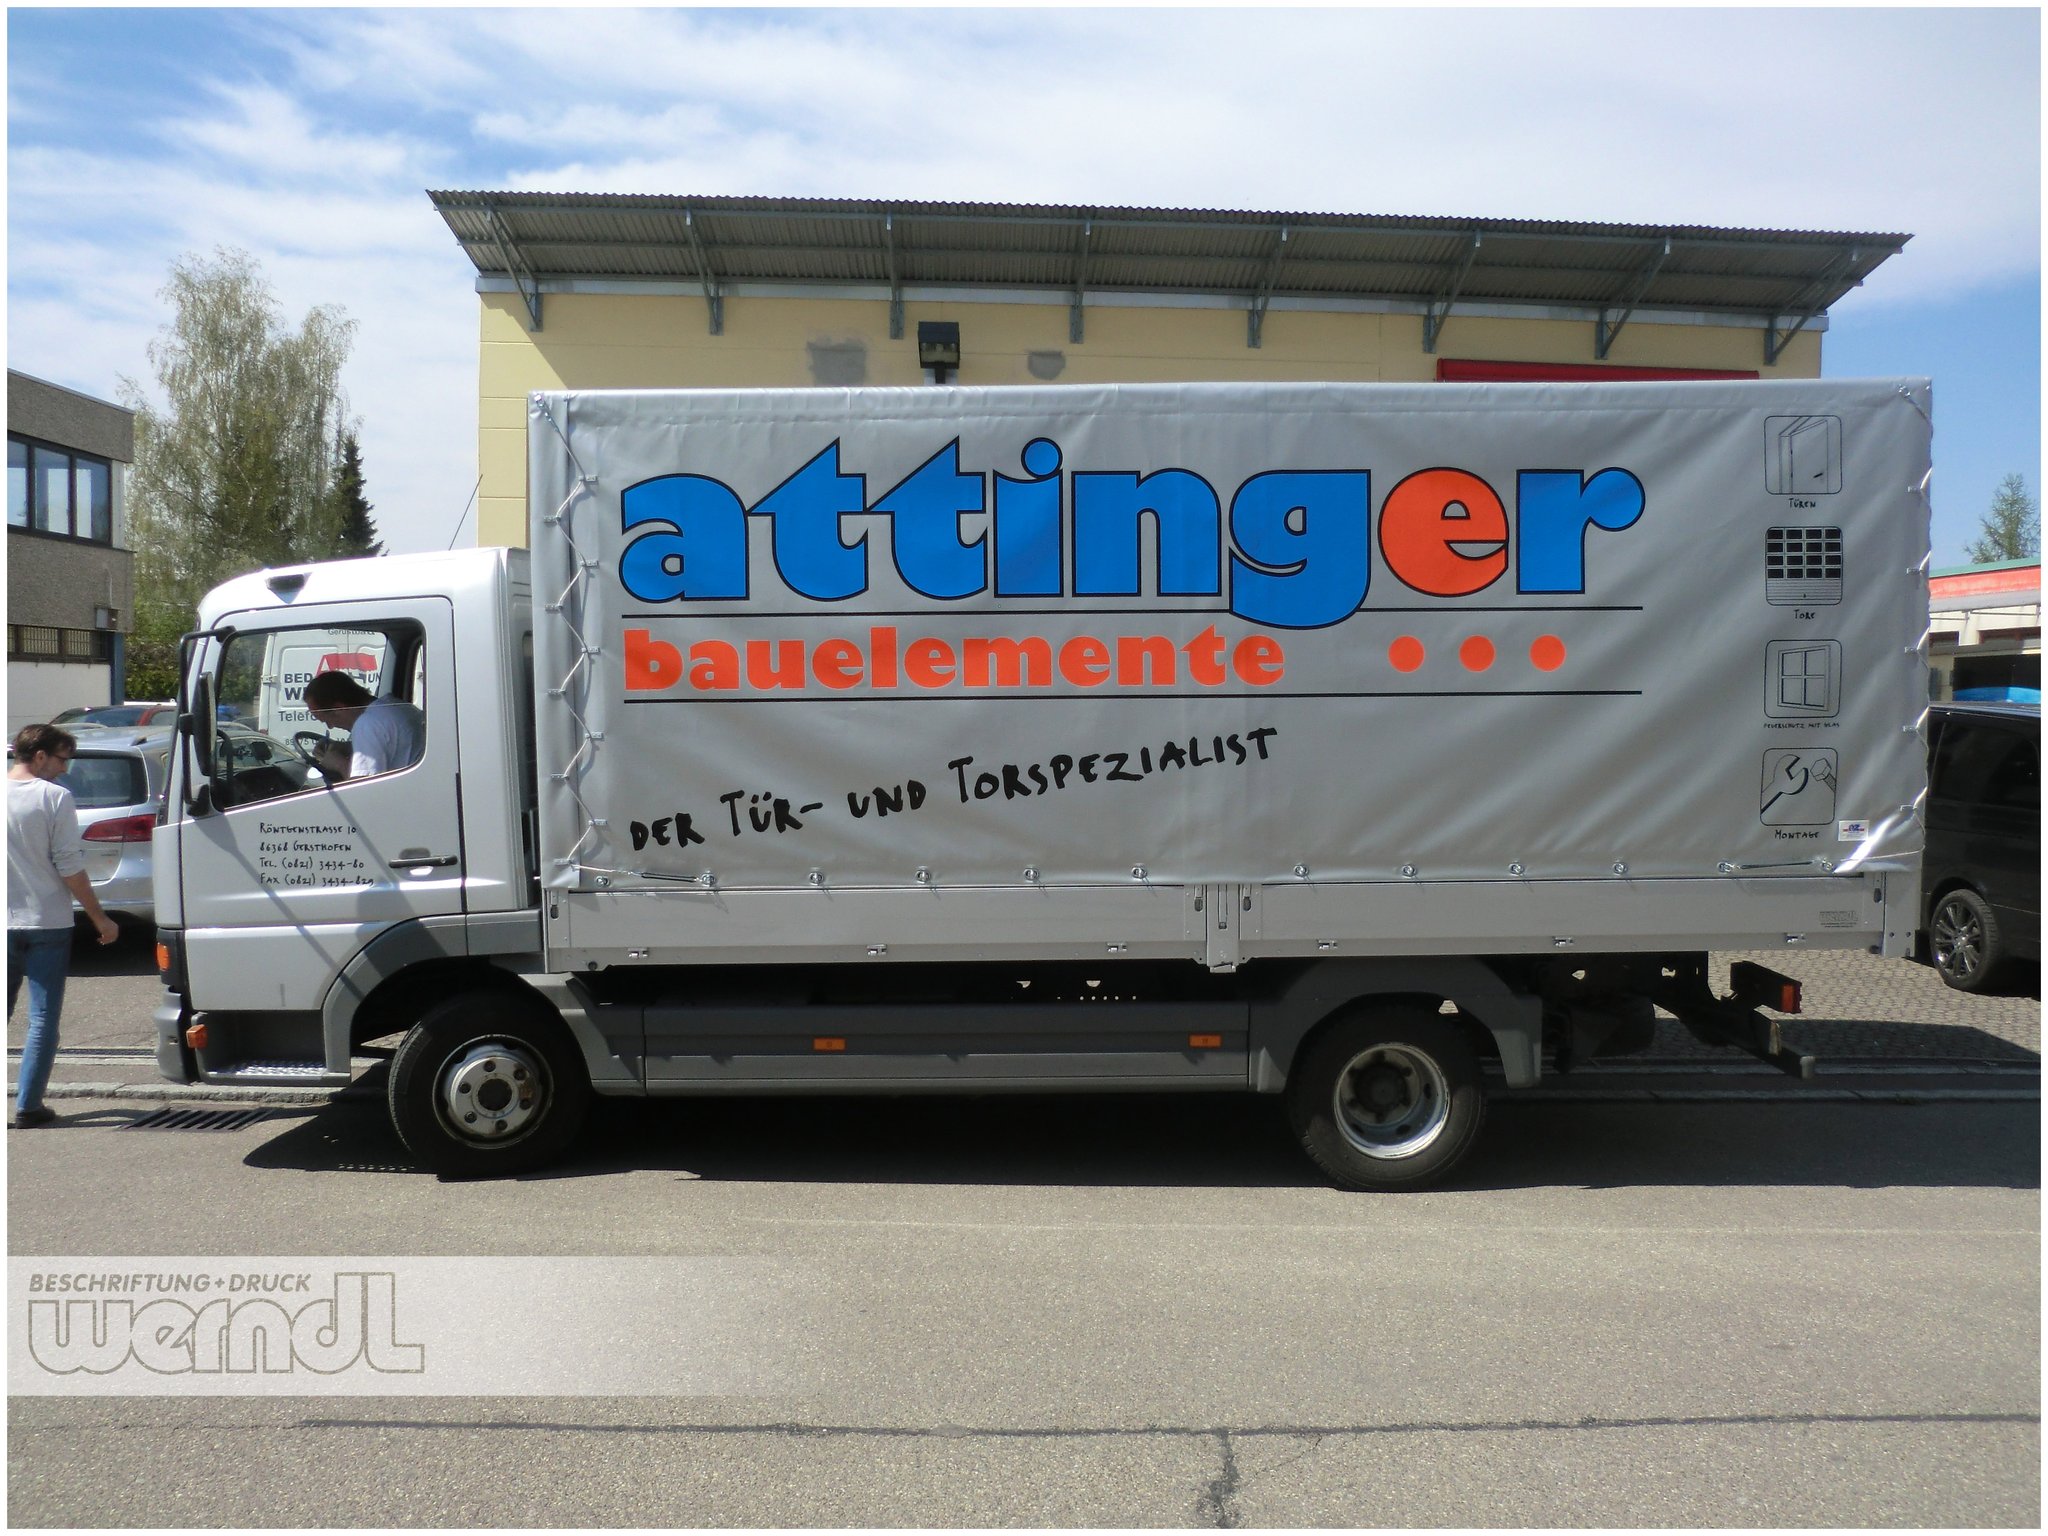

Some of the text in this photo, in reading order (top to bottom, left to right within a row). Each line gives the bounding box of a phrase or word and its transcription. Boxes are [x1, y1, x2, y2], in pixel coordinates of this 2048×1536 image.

[619, 435, 1646, 630] attinger
[624, 624, 1285, 690] bauelemente
[630, 727, 1278, 852] DER TÜR- UND TORSPEZIALIST
[347, 826, 357, 835] 10
[1774, 829, 1820, 840] MONTAGE
[260, 840, 351, 853] 86368 GERSTHOFEN
[282, 856, 313, 869] (0821)
[319, 859, 365, 870] 3434-80
[285, 873, 316, 886] (0821)
